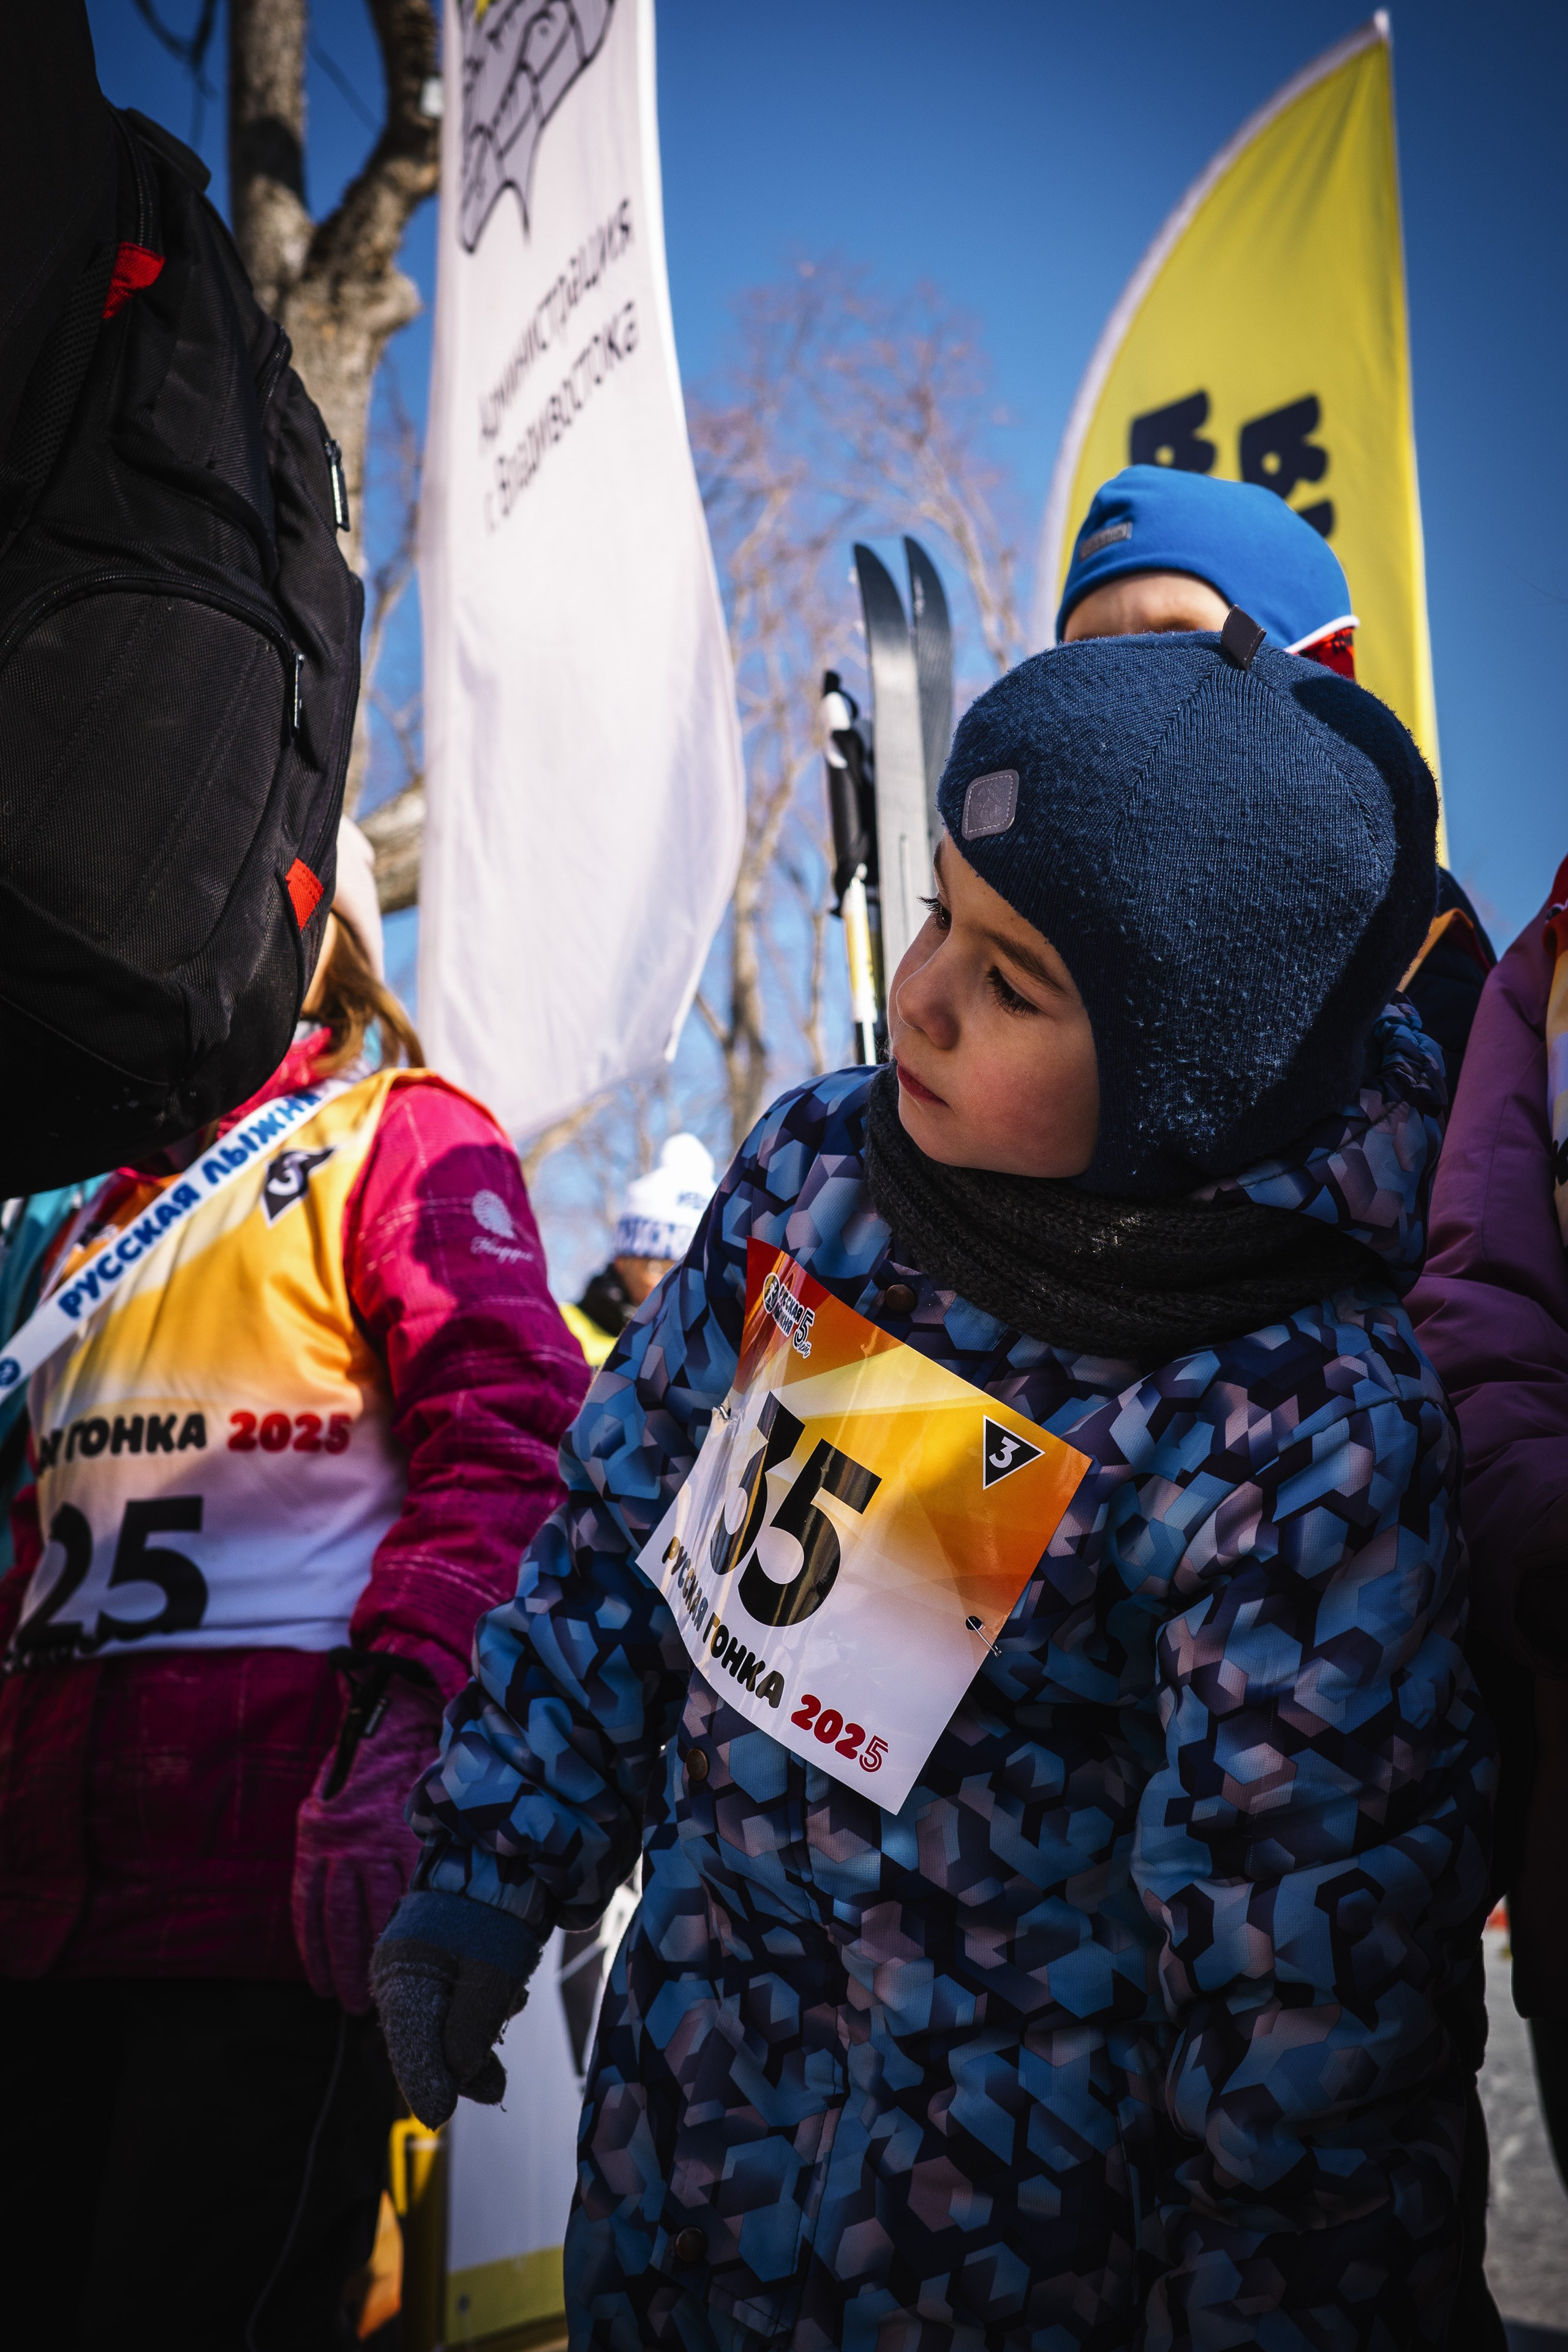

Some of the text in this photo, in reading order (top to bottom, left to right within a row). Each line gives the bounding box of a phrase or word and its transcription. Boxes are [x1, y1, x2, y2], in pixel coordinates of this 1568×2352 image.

[57, 1183, 202, 1318] РУССКАЯ
[793, 1310, 814, 1348] 5
[66, 1412, 206, 1462] ГОНКА
[227, 1409, 353, 1455] 2025
[989, 1436, 1021, 1469] 3
[15, 1496, 208, 1653] 25
[710, 1391, 881, 1627] 35
[662, 1536, 889, 1773] РУССКАЯ ГОНКА 2025
